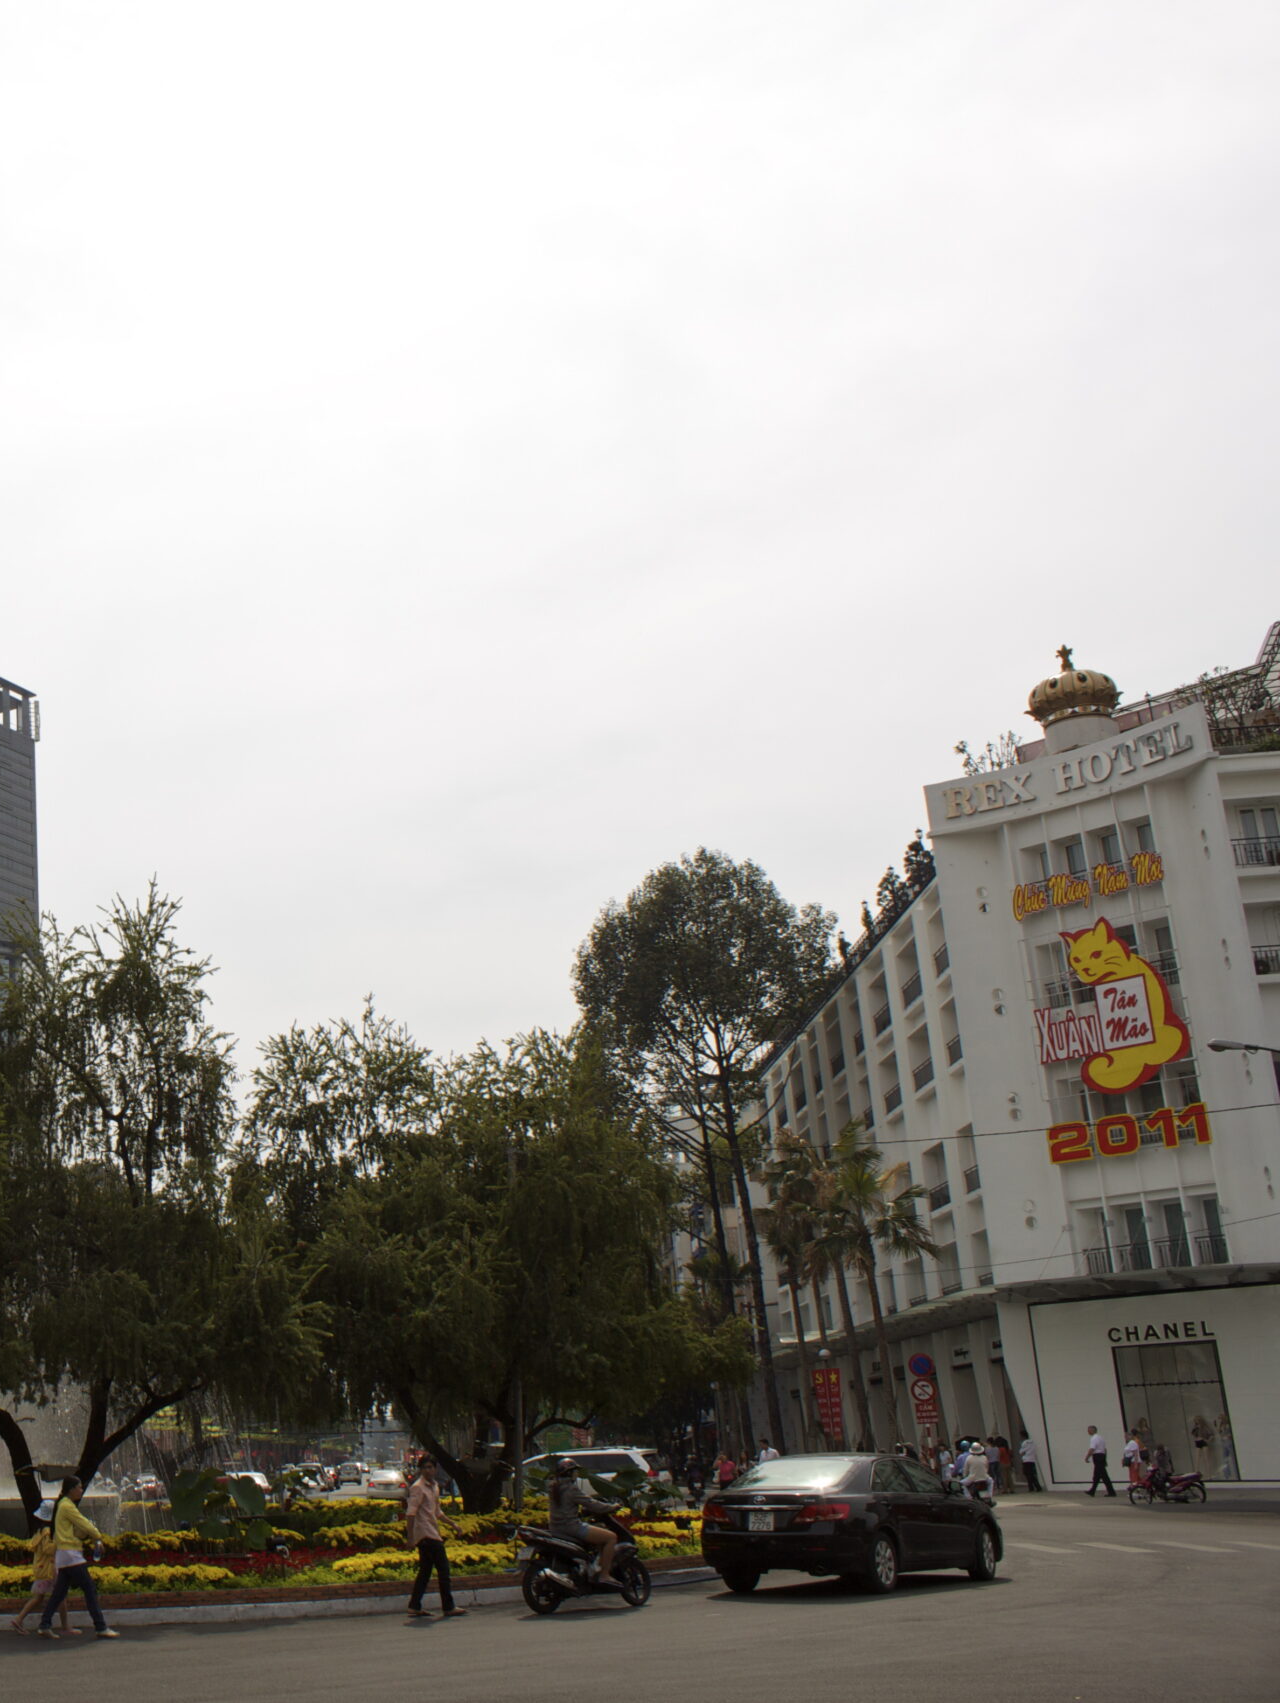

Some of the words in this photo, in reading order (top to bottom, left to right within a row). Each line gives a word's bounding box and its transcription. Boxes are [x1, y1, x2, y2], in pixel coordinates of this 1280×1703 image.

[942, 772, 1036, 819] REX
[1052, 721, 1194, 795] HOTEL
[1012, 882, 1047, 922] Chúc
[1093, 863, 1129, 897] Năm
[1130, 851, 1164, 886] Mới
[1103, 987, 1138, 1013] Tân
[1033, 1007, 1105, 1065] XUÂN
[1105, 1016, 1150, 1043] Mão
[1047, 1101, 1212, 1164] 2011
[1107, 1320, 1215, 1343] CHANEL
